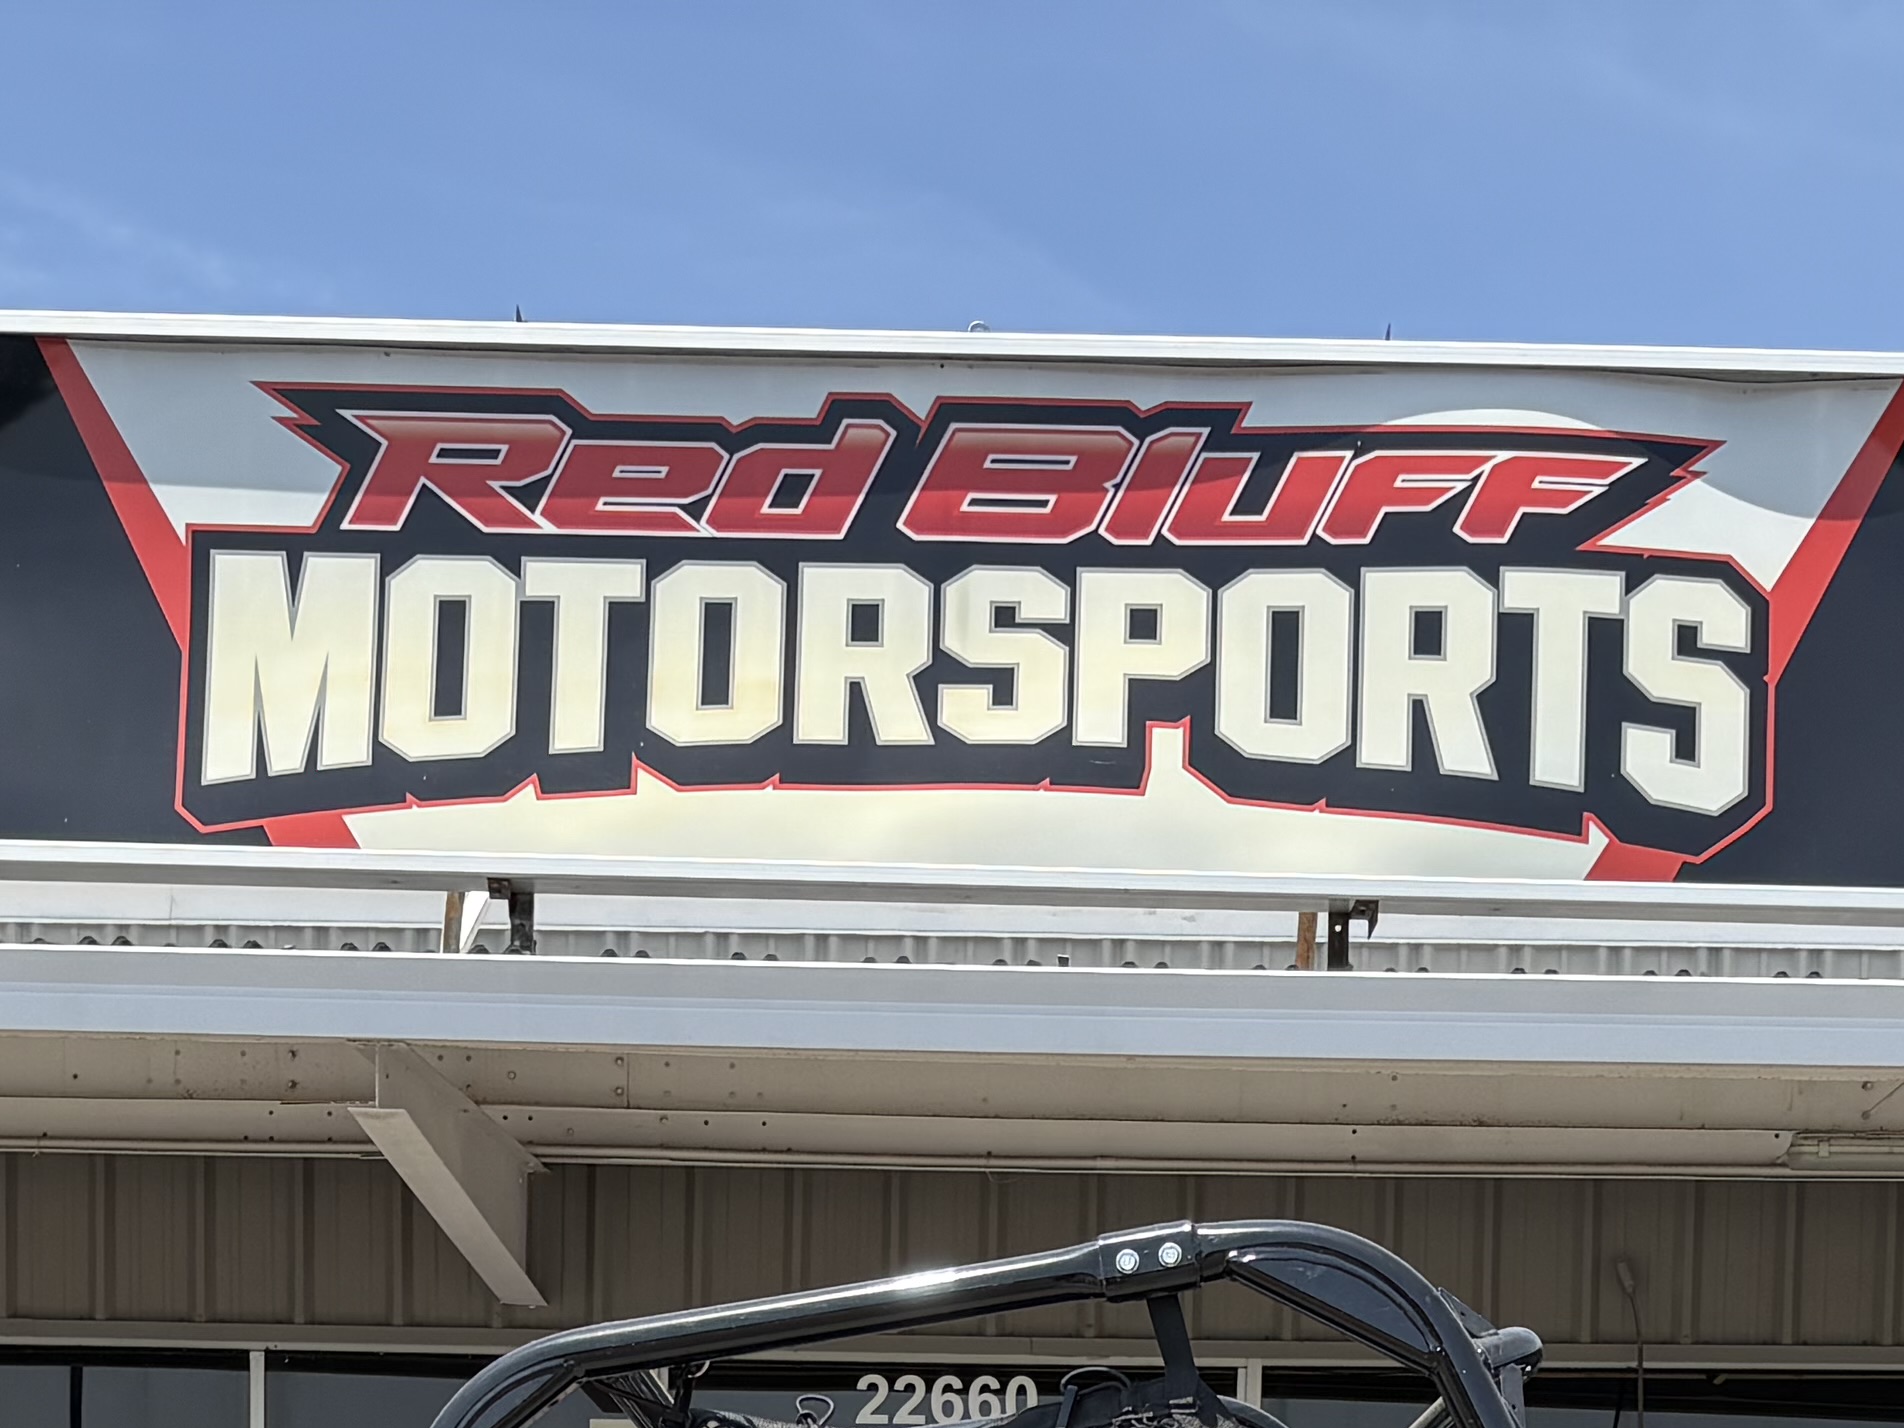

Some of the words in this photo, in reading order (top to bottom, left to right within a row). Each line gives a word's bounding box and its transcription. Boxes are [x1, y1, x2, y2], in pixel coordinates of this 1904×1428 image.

[335, 409, 897, 540] Red
[197, 549, 1758, 816] MOTORSPORTS
[855, 1374, 1038, 1425] 22660
